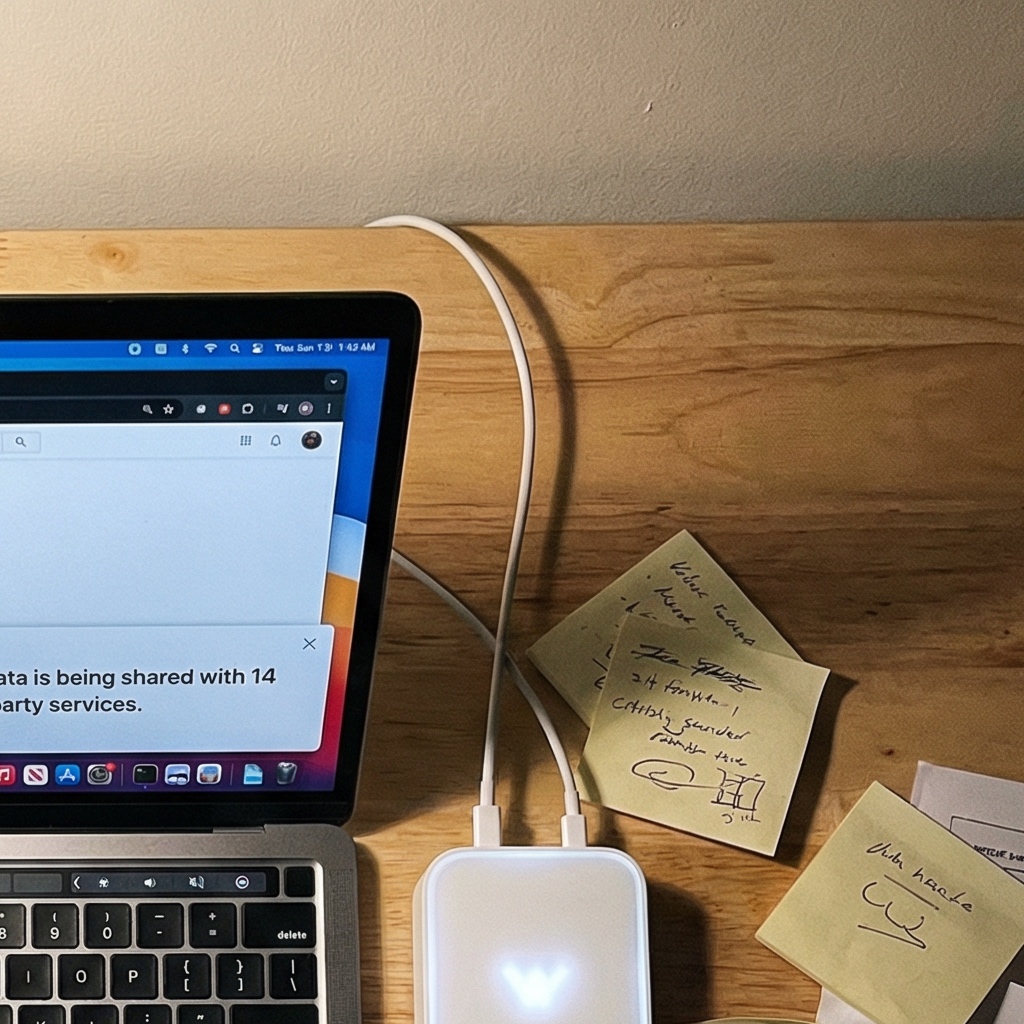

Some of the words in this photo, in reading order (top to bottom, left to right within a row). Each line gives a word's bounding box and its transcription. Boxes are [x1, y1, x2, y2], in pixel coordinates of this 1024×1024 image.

[34, 669, 50, 685] is
[57, 669, 115, 689] being
[122, 669, 193, 685] shared
[200, 668, 244, 684] with
[252, 668, 276, 683] 14
[50, 696, 141, 712] services.
[51, 927, 59, 939] 9
[103, 927, 111, 939] 0
[278, 931, 306, 939] delete
[76, 970, 86, 982] O
[129, 970, 138, 982] P
